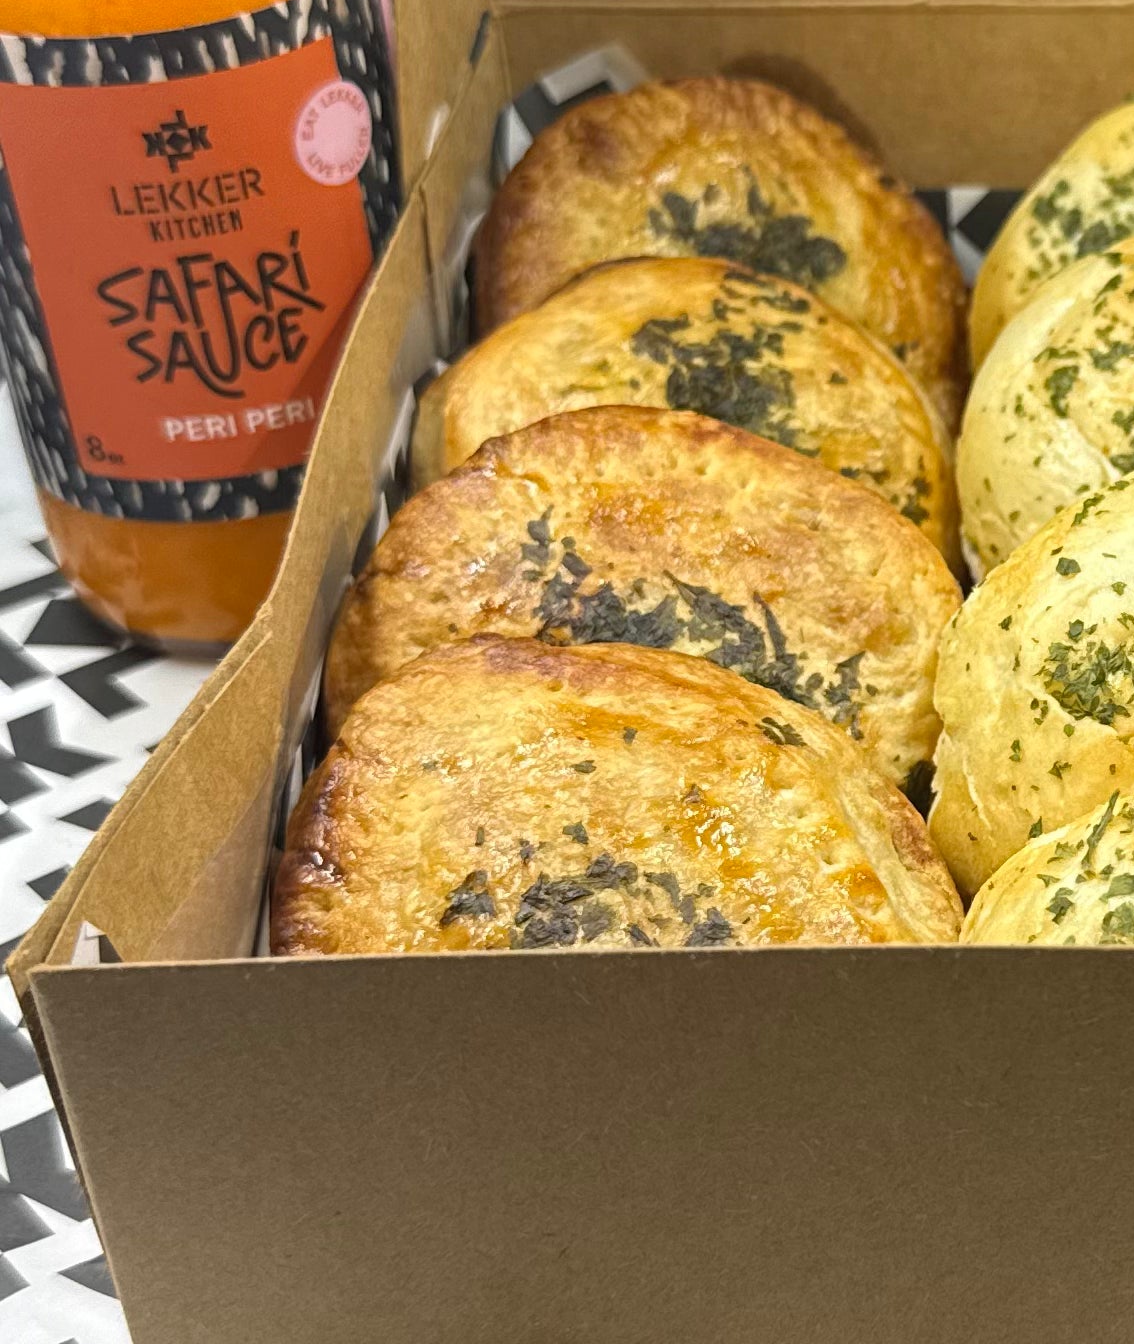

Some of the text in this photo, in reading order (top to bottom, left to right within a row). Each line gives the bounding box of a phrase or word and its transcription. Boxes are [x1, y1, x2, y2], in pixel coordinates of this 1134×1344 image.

[110, 168, 265, 216] LEKKER
[147, 208, 243, 242] KITCHEN
[127, 308, 309, 398] SAUCE
[162, 398, 318, 442] PERI PERI
